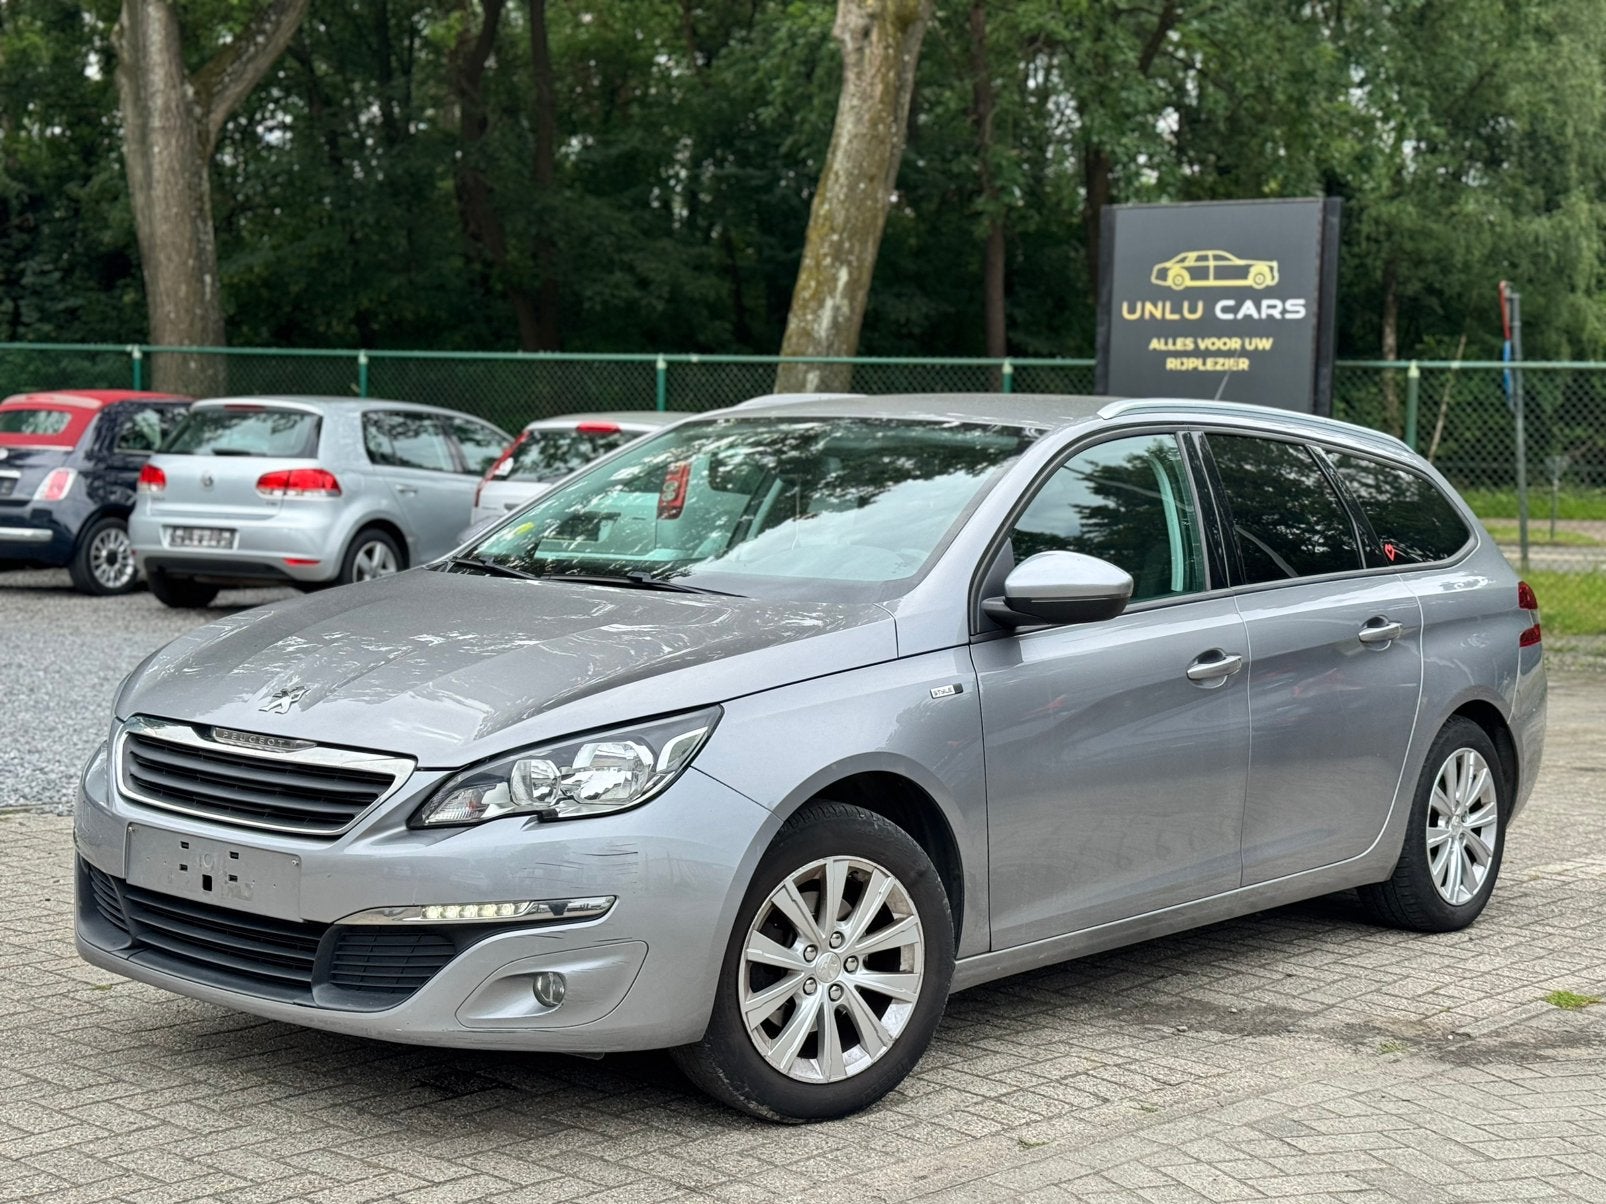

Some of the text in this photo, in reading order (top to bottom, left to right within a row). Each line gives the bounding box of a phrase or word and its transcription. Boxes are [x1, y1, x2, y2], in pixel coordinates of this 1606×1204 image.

[1121, 298, 1307, 321] UNLU CARS
[1148, 337, 1274, 351] ALLES VOOR UW
[1165, 357, 1250, 371] RIJPLEZIER
[222, 731, 286, 747] PEUGEOT
